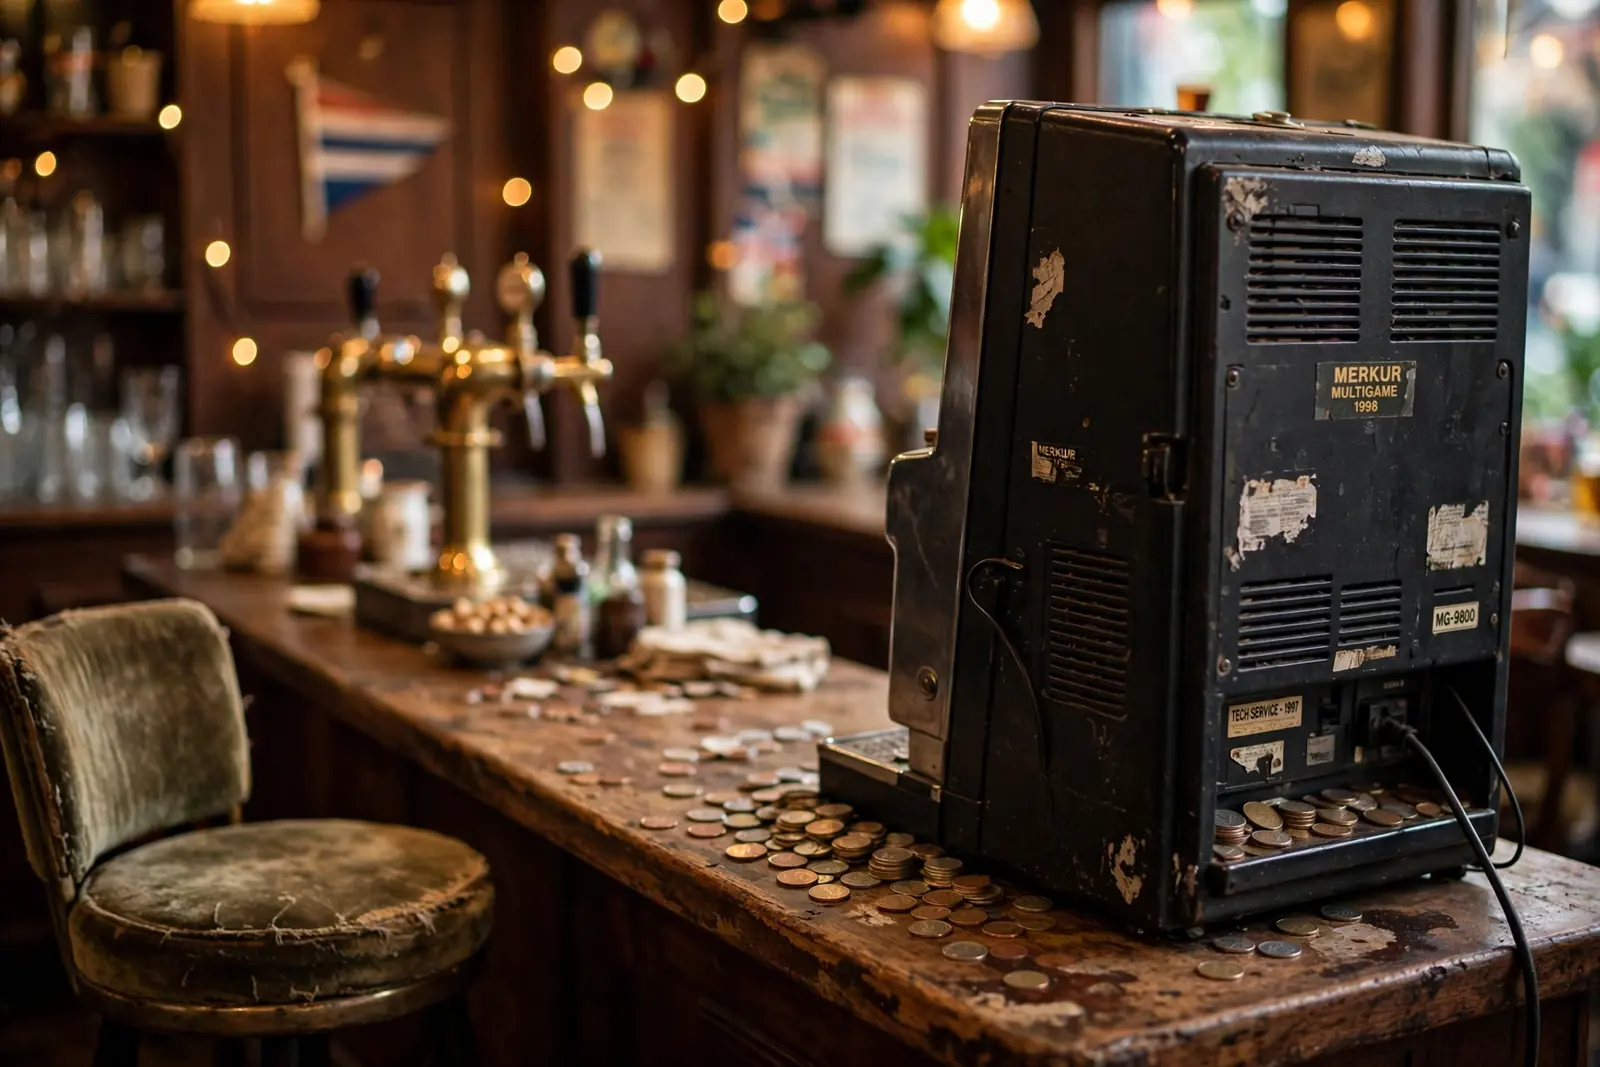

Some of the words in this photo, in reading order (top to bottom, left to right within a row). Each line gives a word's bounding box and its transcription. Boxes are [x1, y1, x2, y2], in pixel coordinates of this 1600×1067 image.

[1334, 365, 1401, 383] MERKUR
[1331, 385, 1398, 399] MULTIGAME
[1354, 400, 1378, 412] 1998
[1435, 608, 1475, 626] MG-9800
[1232, 708, 1249, 721] TECH
[1250, 703, 1279, 718] SERVICE
[1284, 700, 1299, 714] 1997
